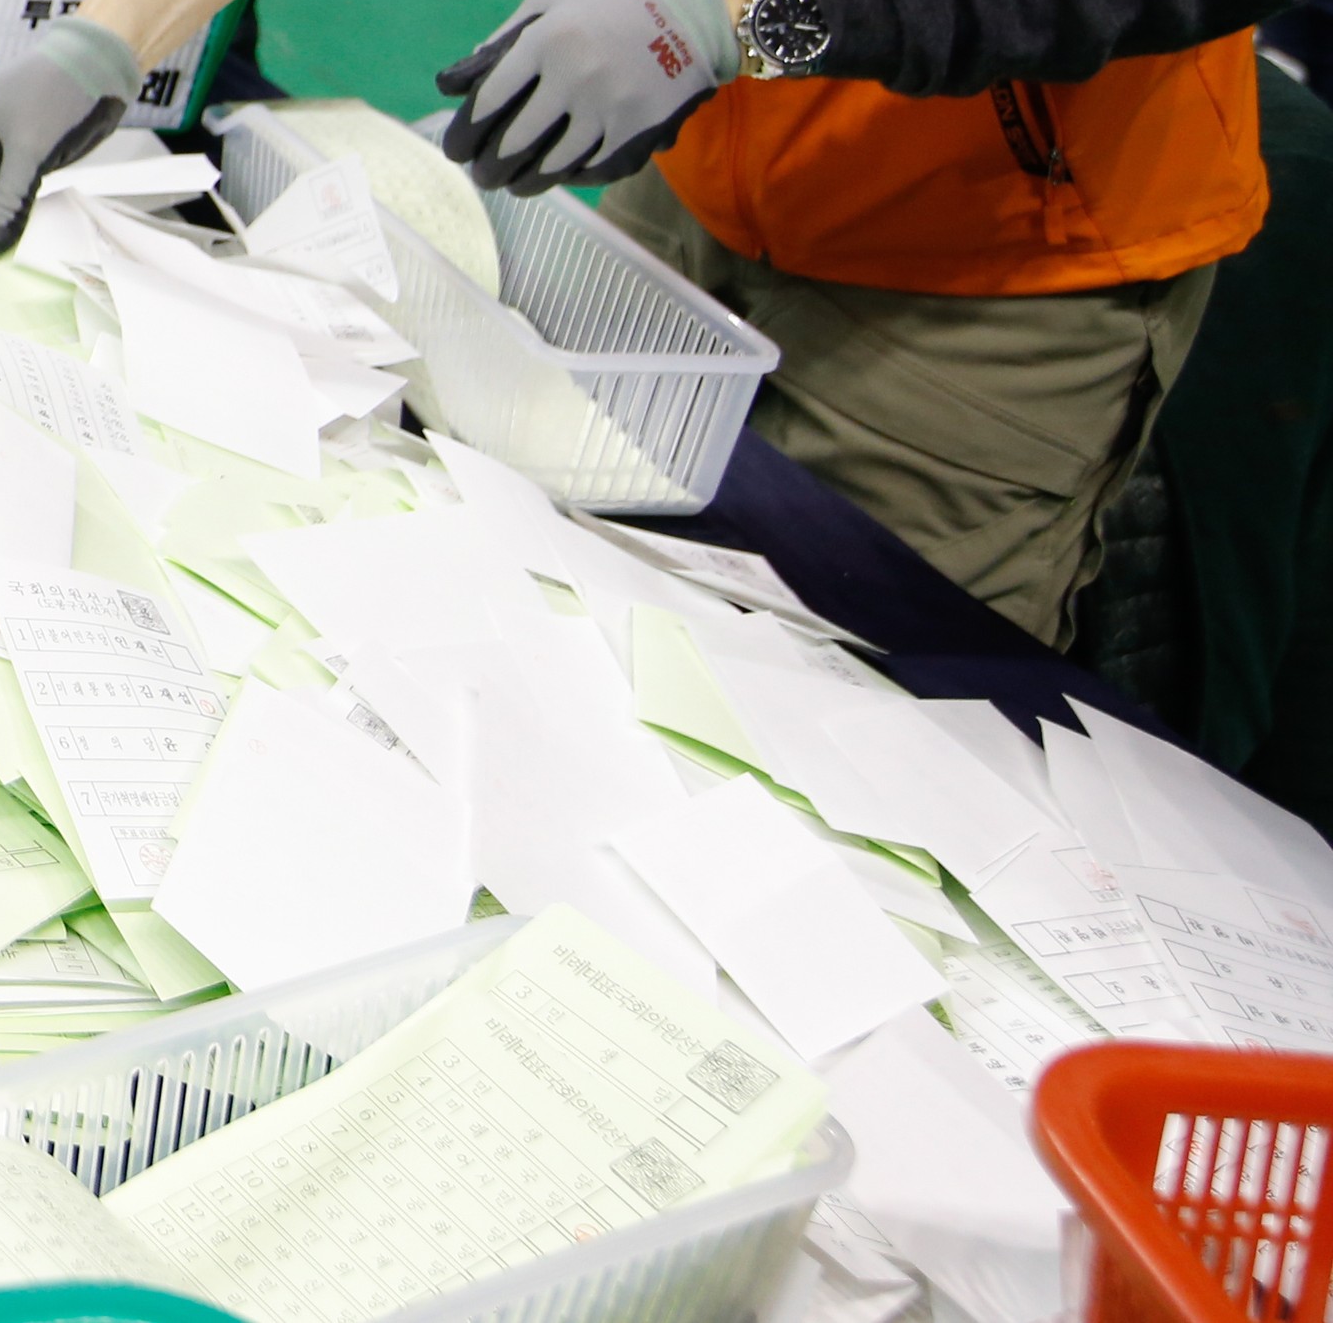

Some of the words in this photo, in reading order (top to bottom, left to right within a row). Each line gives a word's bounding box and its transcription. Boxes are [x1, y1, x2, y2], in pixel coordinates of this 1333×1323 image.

[647, 34, 682, 80] 3M
[35, 628, 109, 647] 더불어민주당
[36, 682, 49, 696] 2
[55, 681, 132, 698] 미래통합당
[58, 736, 70, 749] 6
[77, 735, 155, 752] 정의당
[81, 791, 91, 806] 7
[515, 985, 534, 1001] 3
[546, 1006, 674, 1106] 민생당
[330, 1124, 349, 1138] 7
[443, 1054, 461, 1070] 3
[472, 1078, 594, 1192] 민생당
[300, 1140, 319, 1154] 8
[416, 1074, 433, 1090] 4
[446, 1097, 566, 1209] 미래한국당
[271, 1155, 290, 1169] 9
[387, 1090, 406, 1106] 5
[415, 1115, 537, 1226] 더불어시민당
[239, 1168, 265, 1189] 10
[358, 1108, 378, 1122] 6
[387, 1131, 508, 1244] 정의당
[210, 1184, 234, 1204] 11
[150, 1216, 175, 1237] 13
[181, 1200, 205, 1221] 12
[210, 1229, 302, 1317] 열린민주
